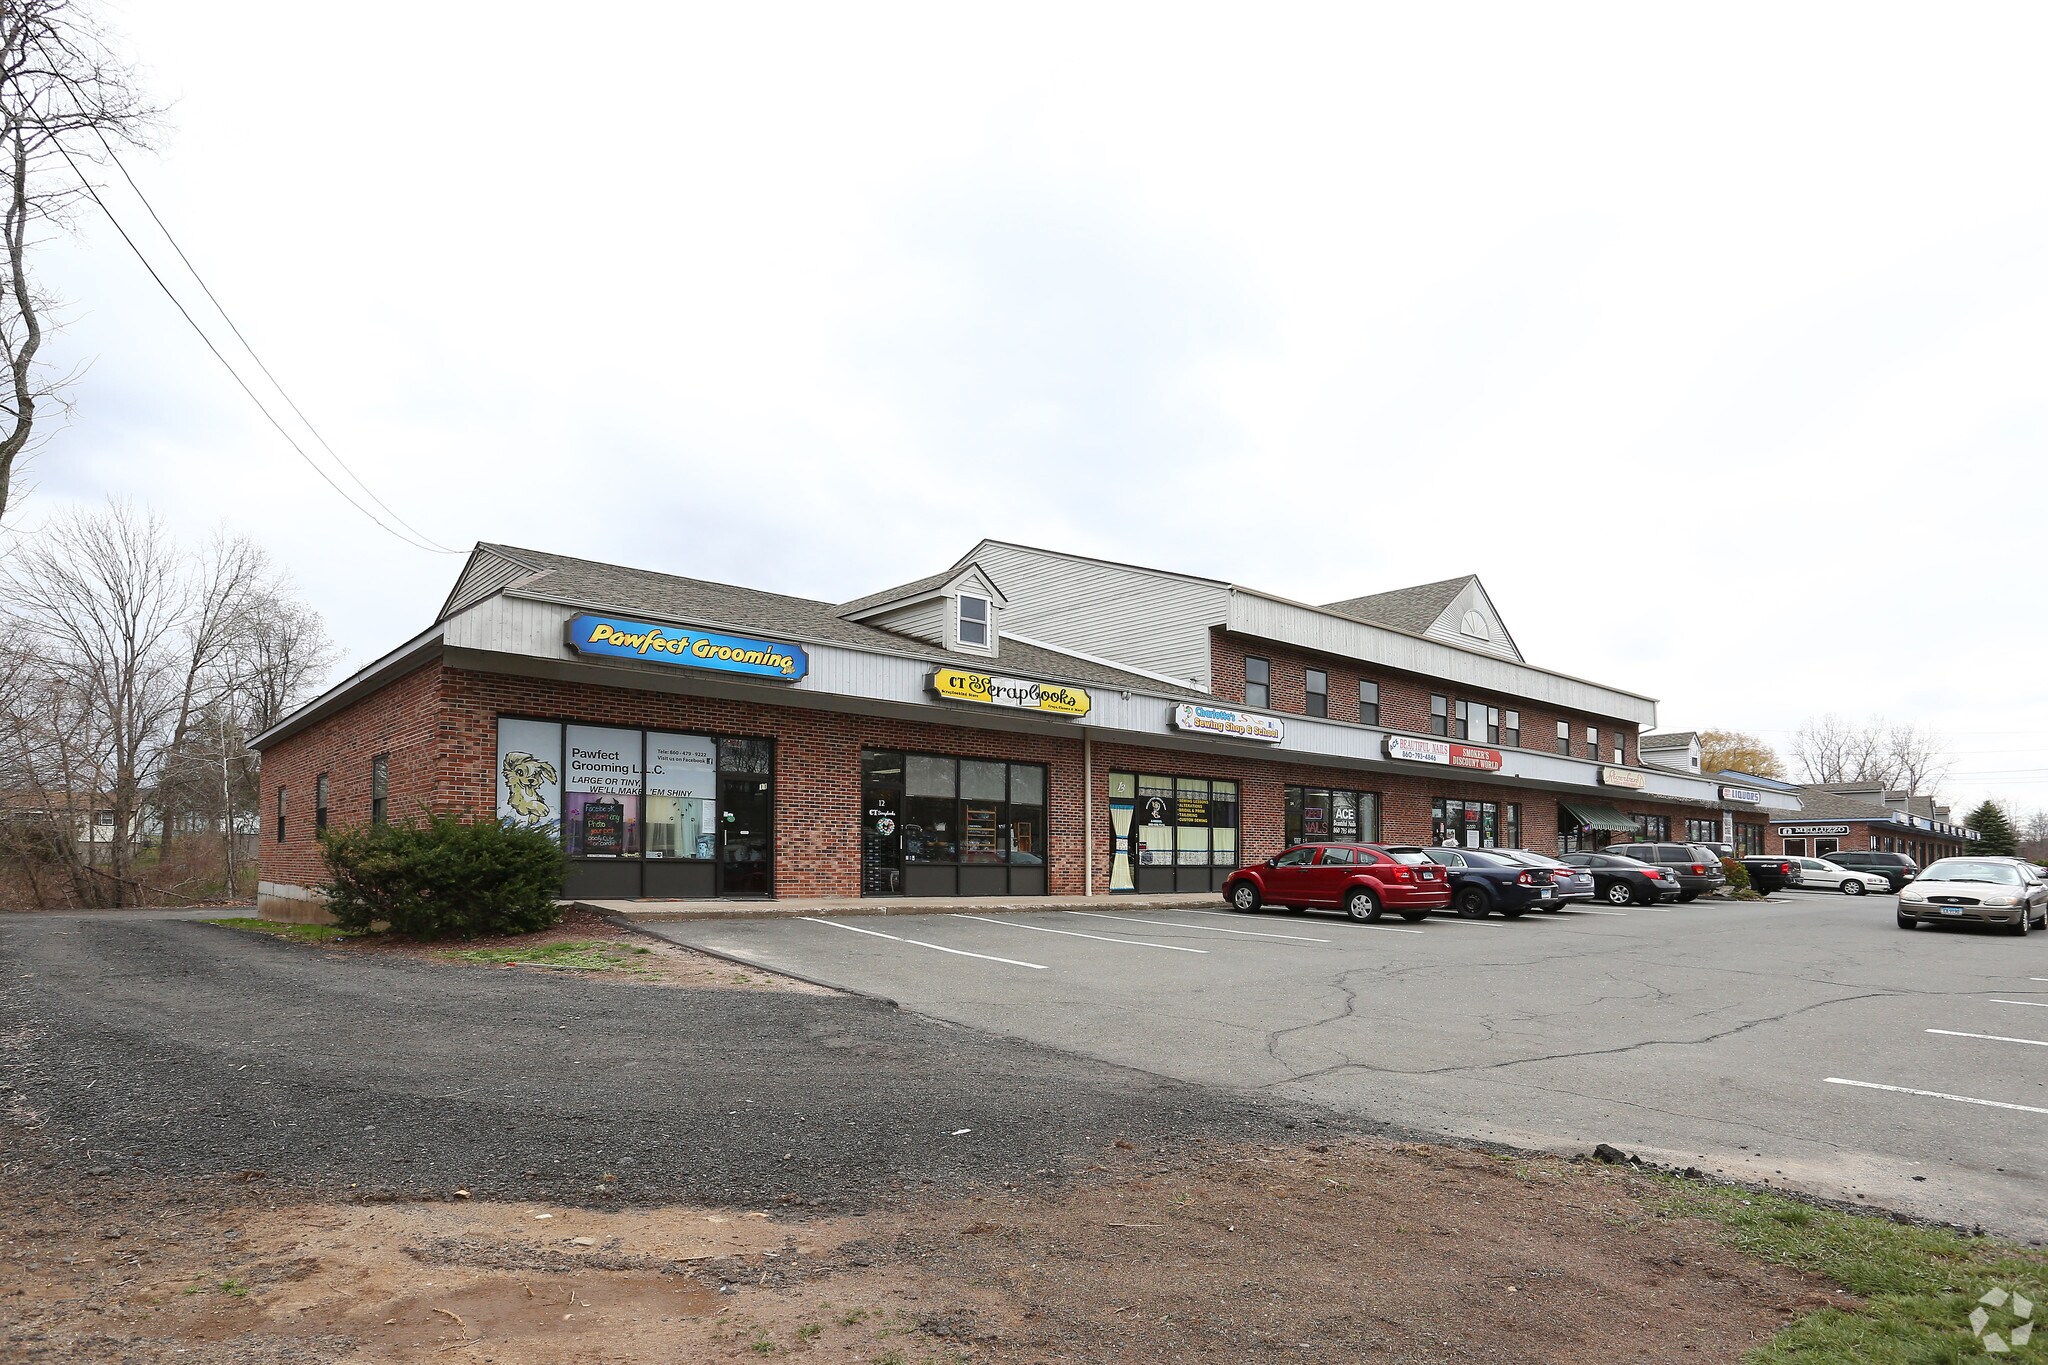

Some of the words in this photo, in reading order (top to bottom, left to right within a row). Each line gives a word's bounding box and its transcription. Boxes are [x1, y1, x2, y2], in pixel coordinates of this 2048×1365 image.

[588, 623, 690, 654] Pawfect
[691, 639, 796, 675] Grooming
[949, 676, 966, 689] CT
[969, 675, 1076, 706] Scrapbooks
[1194, 717, 1224, 733] Sewing
[1225, 722, 1245, 735] Shop
[1253, 726, 1279, 738] School
[1390, 739, 1399, 751] ACE
[1400, 739, 1431, 752] BEAUTIFUL
[1432, 744, 1448, 755] NAILS
[572, 748, 619, 760] Pawfect
[1462, 748, 1490, 760] SMOKER'S
[572, 760, 629, 775] Grooming
[1452, 755, 1480, 768] DISCOUNT
[1480, 759, 1499, 770] WORLD
[572, 776, 602, 785] LARGE
[620, 779, 641, 788] TINY,
[590, 786, 616, 794] WE'LL
[1731, 790, 1759, 801] LIQUORS
[1335, 809, 1354, 820] ACE
[1304, 822, 1328, 834] NAILS
